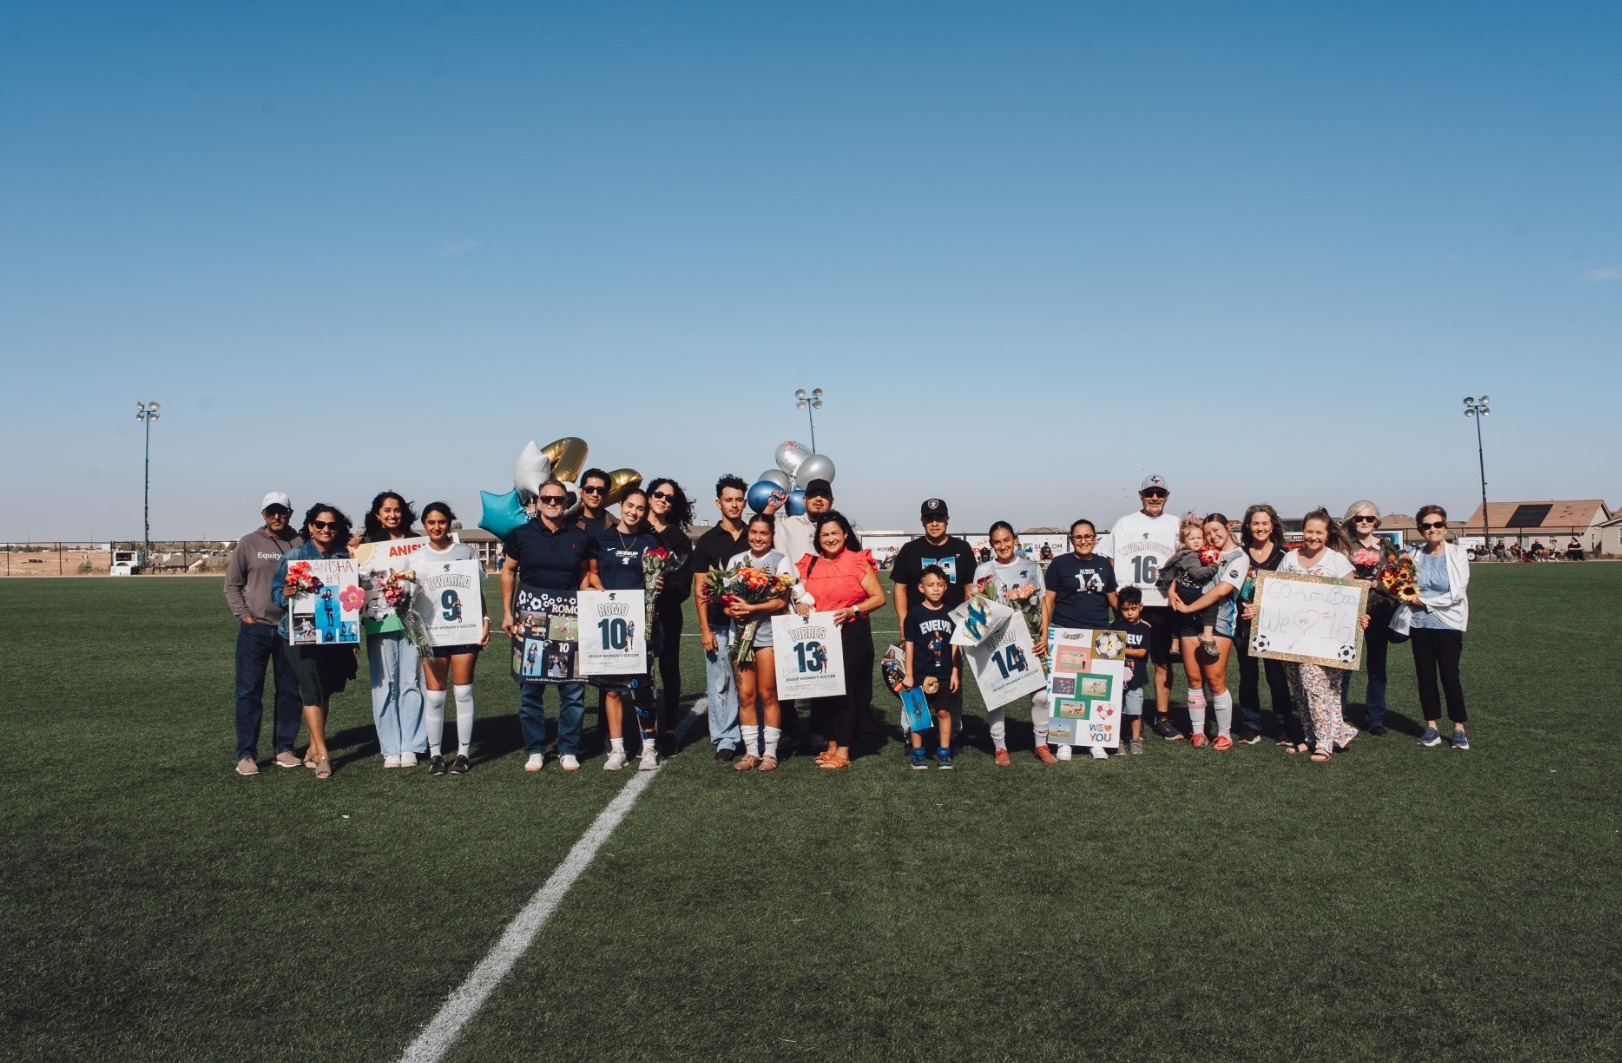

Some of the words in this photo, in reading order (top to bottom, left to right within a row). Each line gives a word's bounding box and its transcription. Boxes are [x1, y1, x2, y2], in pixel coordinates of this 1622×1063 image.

[257, 552, 282, 560] Equity
[313, 560, 354, 573] ANISHA
[1131, 555, 1158, 584] 16
[425, 573, 472, 591] DWARKA
[441, 589, 460, 621] 9
[597, 602, 630, 617] ROMO
[597, 617, 629, 650] 10
[788, 626, 827, 642] TORRES
[919, 619, 952, 635] EVELYN
[558, 642, 570, 653] 10
[793, 641, 822, 673] 13
[991, 643, 1025, 680] 14
[1089, 723, 1104, 732] WE
[1089, 733, 1112, 742] YOU
